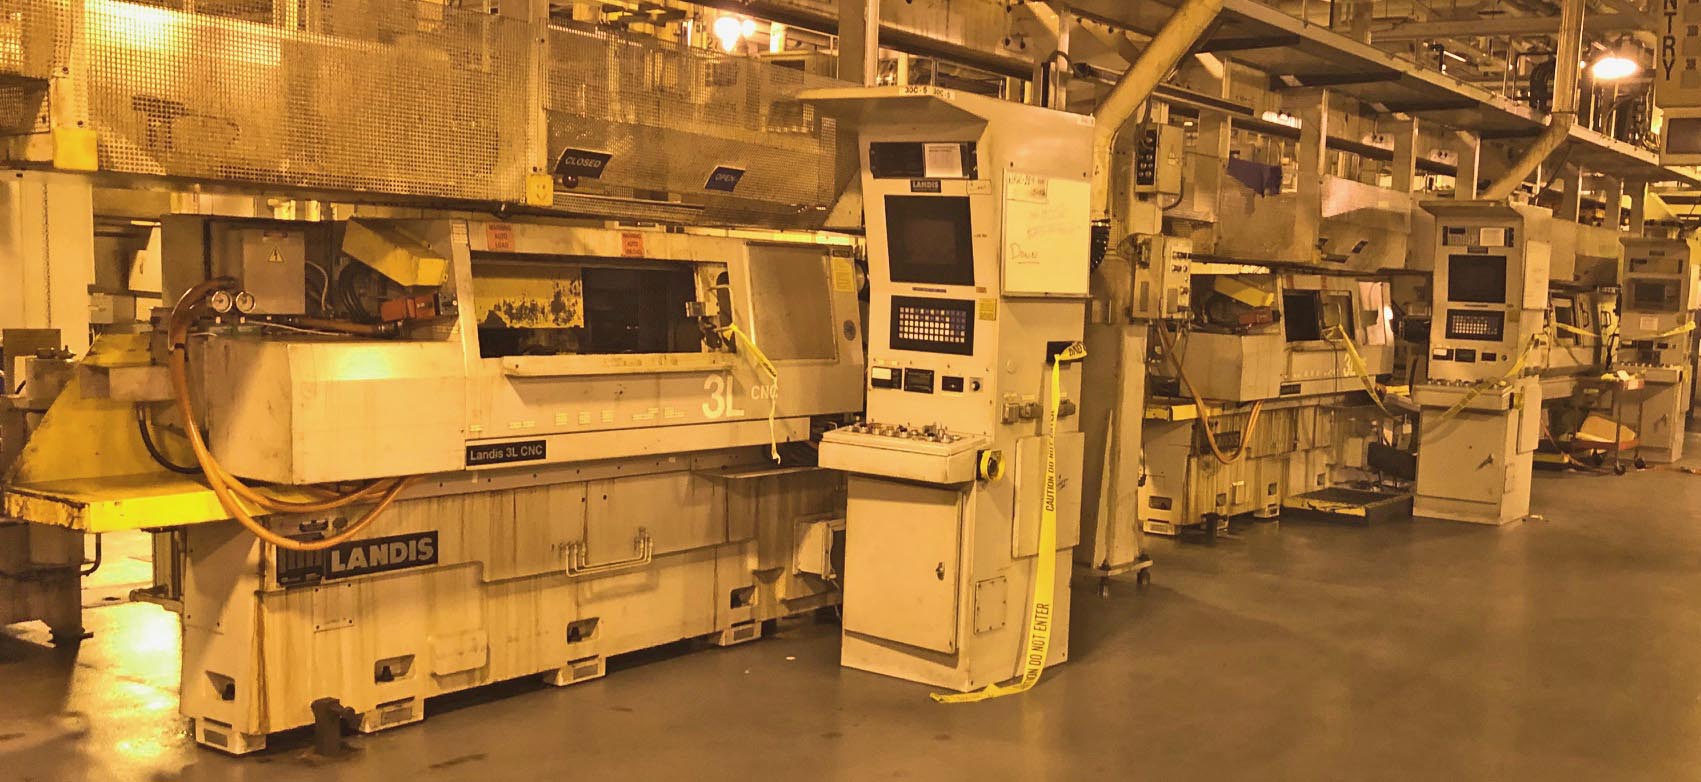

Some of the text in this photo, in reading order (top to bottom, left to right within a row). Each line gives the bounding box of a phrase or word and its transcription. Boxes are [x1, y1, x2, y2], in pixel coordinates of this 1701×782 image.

[565, 156, 602, 169] CLOSED
[715, 173, 736, 183] OPEN
[913, 180, 939, 188] LANDIS
[702, 373, 779, 419] 3L CNC
[470, 444, 543, 461] Landis 3L CNC
[1046, 475, 1055, 512] CAUTION
[331, 537, 434, 573] LANDIS
[1034, 603, 1049, 632] ENTER
[1032, 634, 1045, 652] NOT
[1029, 654, 1042, 666] DO
